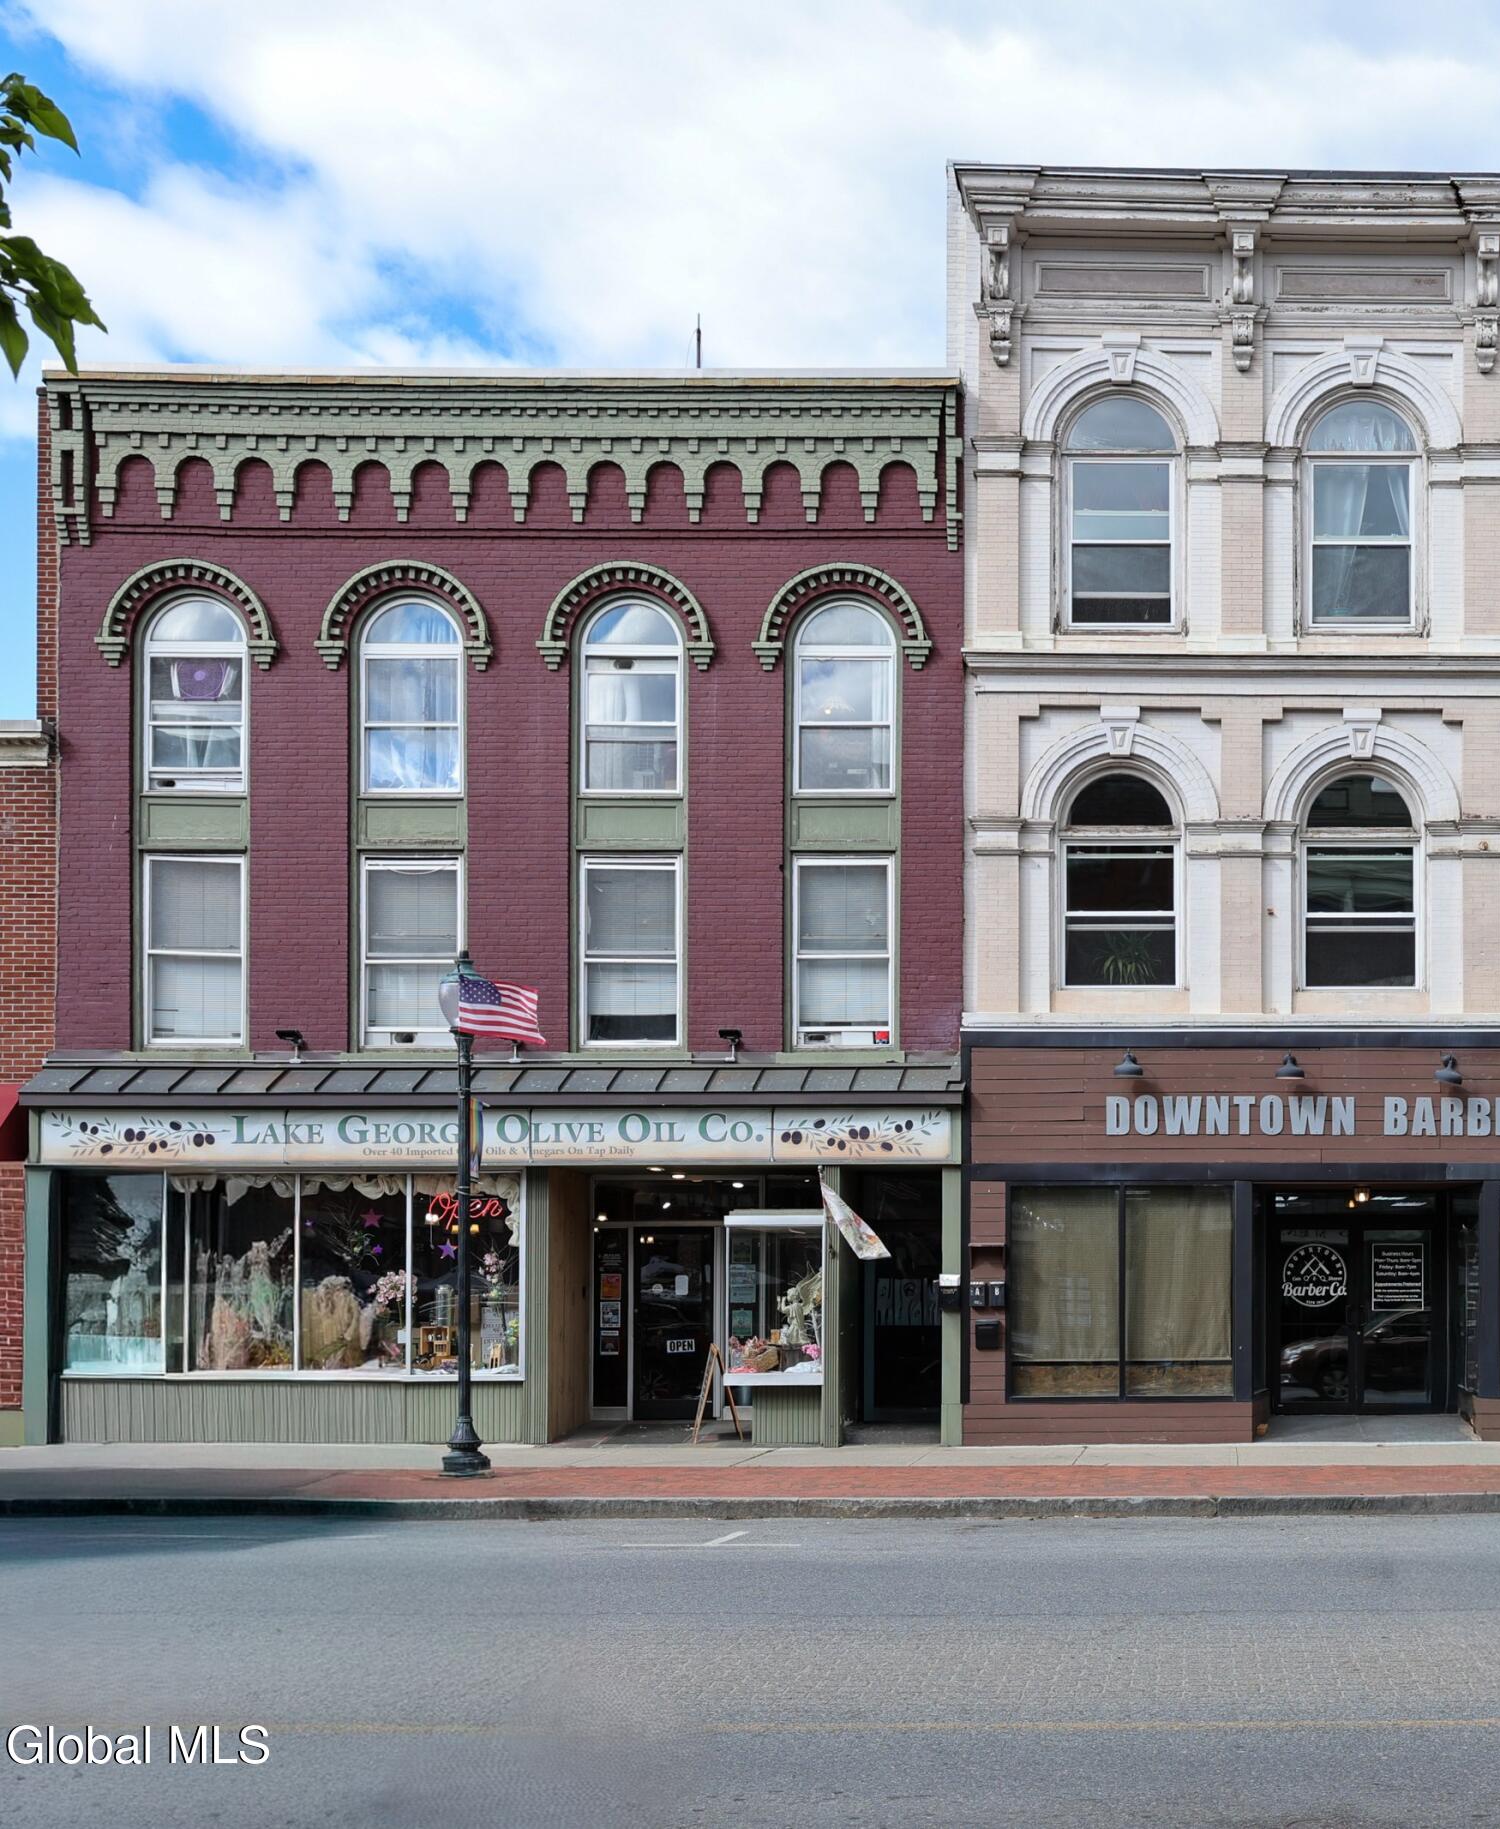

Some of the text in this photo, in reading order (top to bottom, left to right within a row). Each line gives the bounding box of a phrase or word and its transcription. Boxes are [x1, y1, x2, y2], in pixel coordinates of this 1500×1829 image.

[1105, 1095, 1356, 1136] DOWNTOWN
[231, 1113, 764, 1145] LAKE GEORG OLIVE OIL CO.
[363, 1147, 387, 1156] Over
[390, 1147, 402, 1156] 40
[406, 1147, 453, 1158] Imported
[486, 1145, 635, 1157] Oils & Vnegars On Tap Daily
[1282, 1282, 1329, 1296] Barber
[669, 1341, 694, 1352] OPEN
